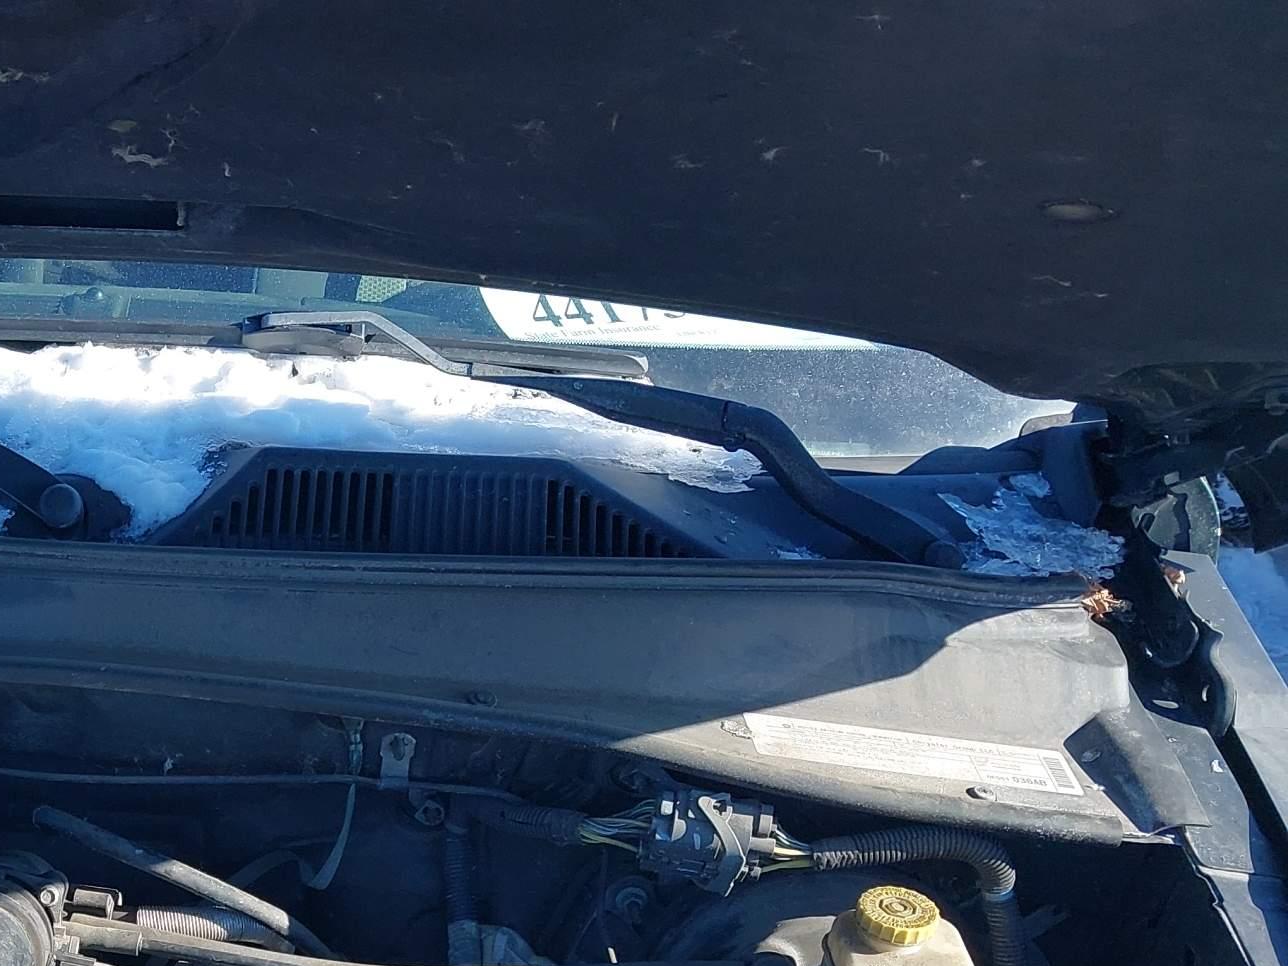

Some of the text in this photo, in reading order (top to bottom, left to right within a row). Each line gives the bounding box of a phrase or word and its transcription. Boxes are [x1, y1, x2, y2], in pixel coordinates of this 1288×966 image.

[524, 324, 660, 341] State Farm Insurance
